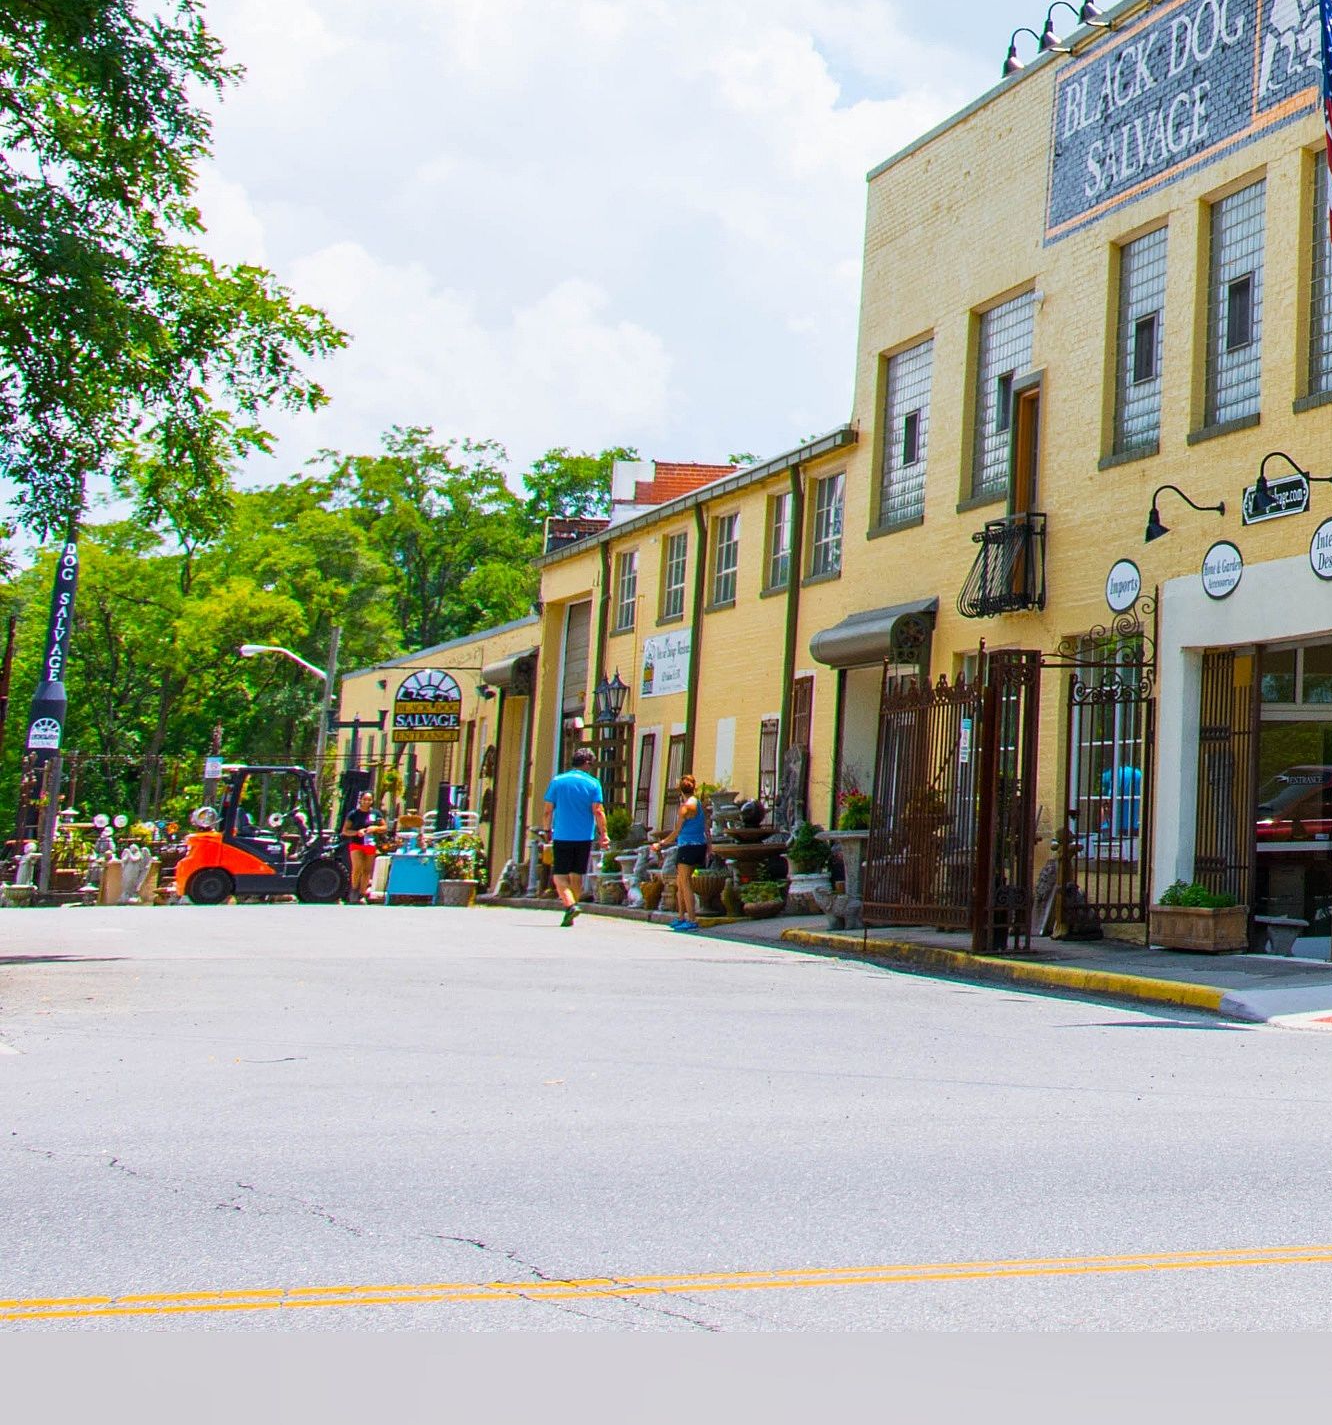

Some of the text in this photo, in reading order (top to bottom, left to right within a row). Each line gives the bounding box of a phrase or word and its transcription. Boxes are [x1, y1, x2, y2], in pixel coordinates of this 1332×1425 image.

[1064, 30, 1158, 139] BLACK
[1085, 80, 1211, 197] SALVAGE
[47, 542, 77, 682] DOG SALVAGE
[1110, 577, 1138, 597] Imports
[395, 714, 458, 727] SALVAGE
